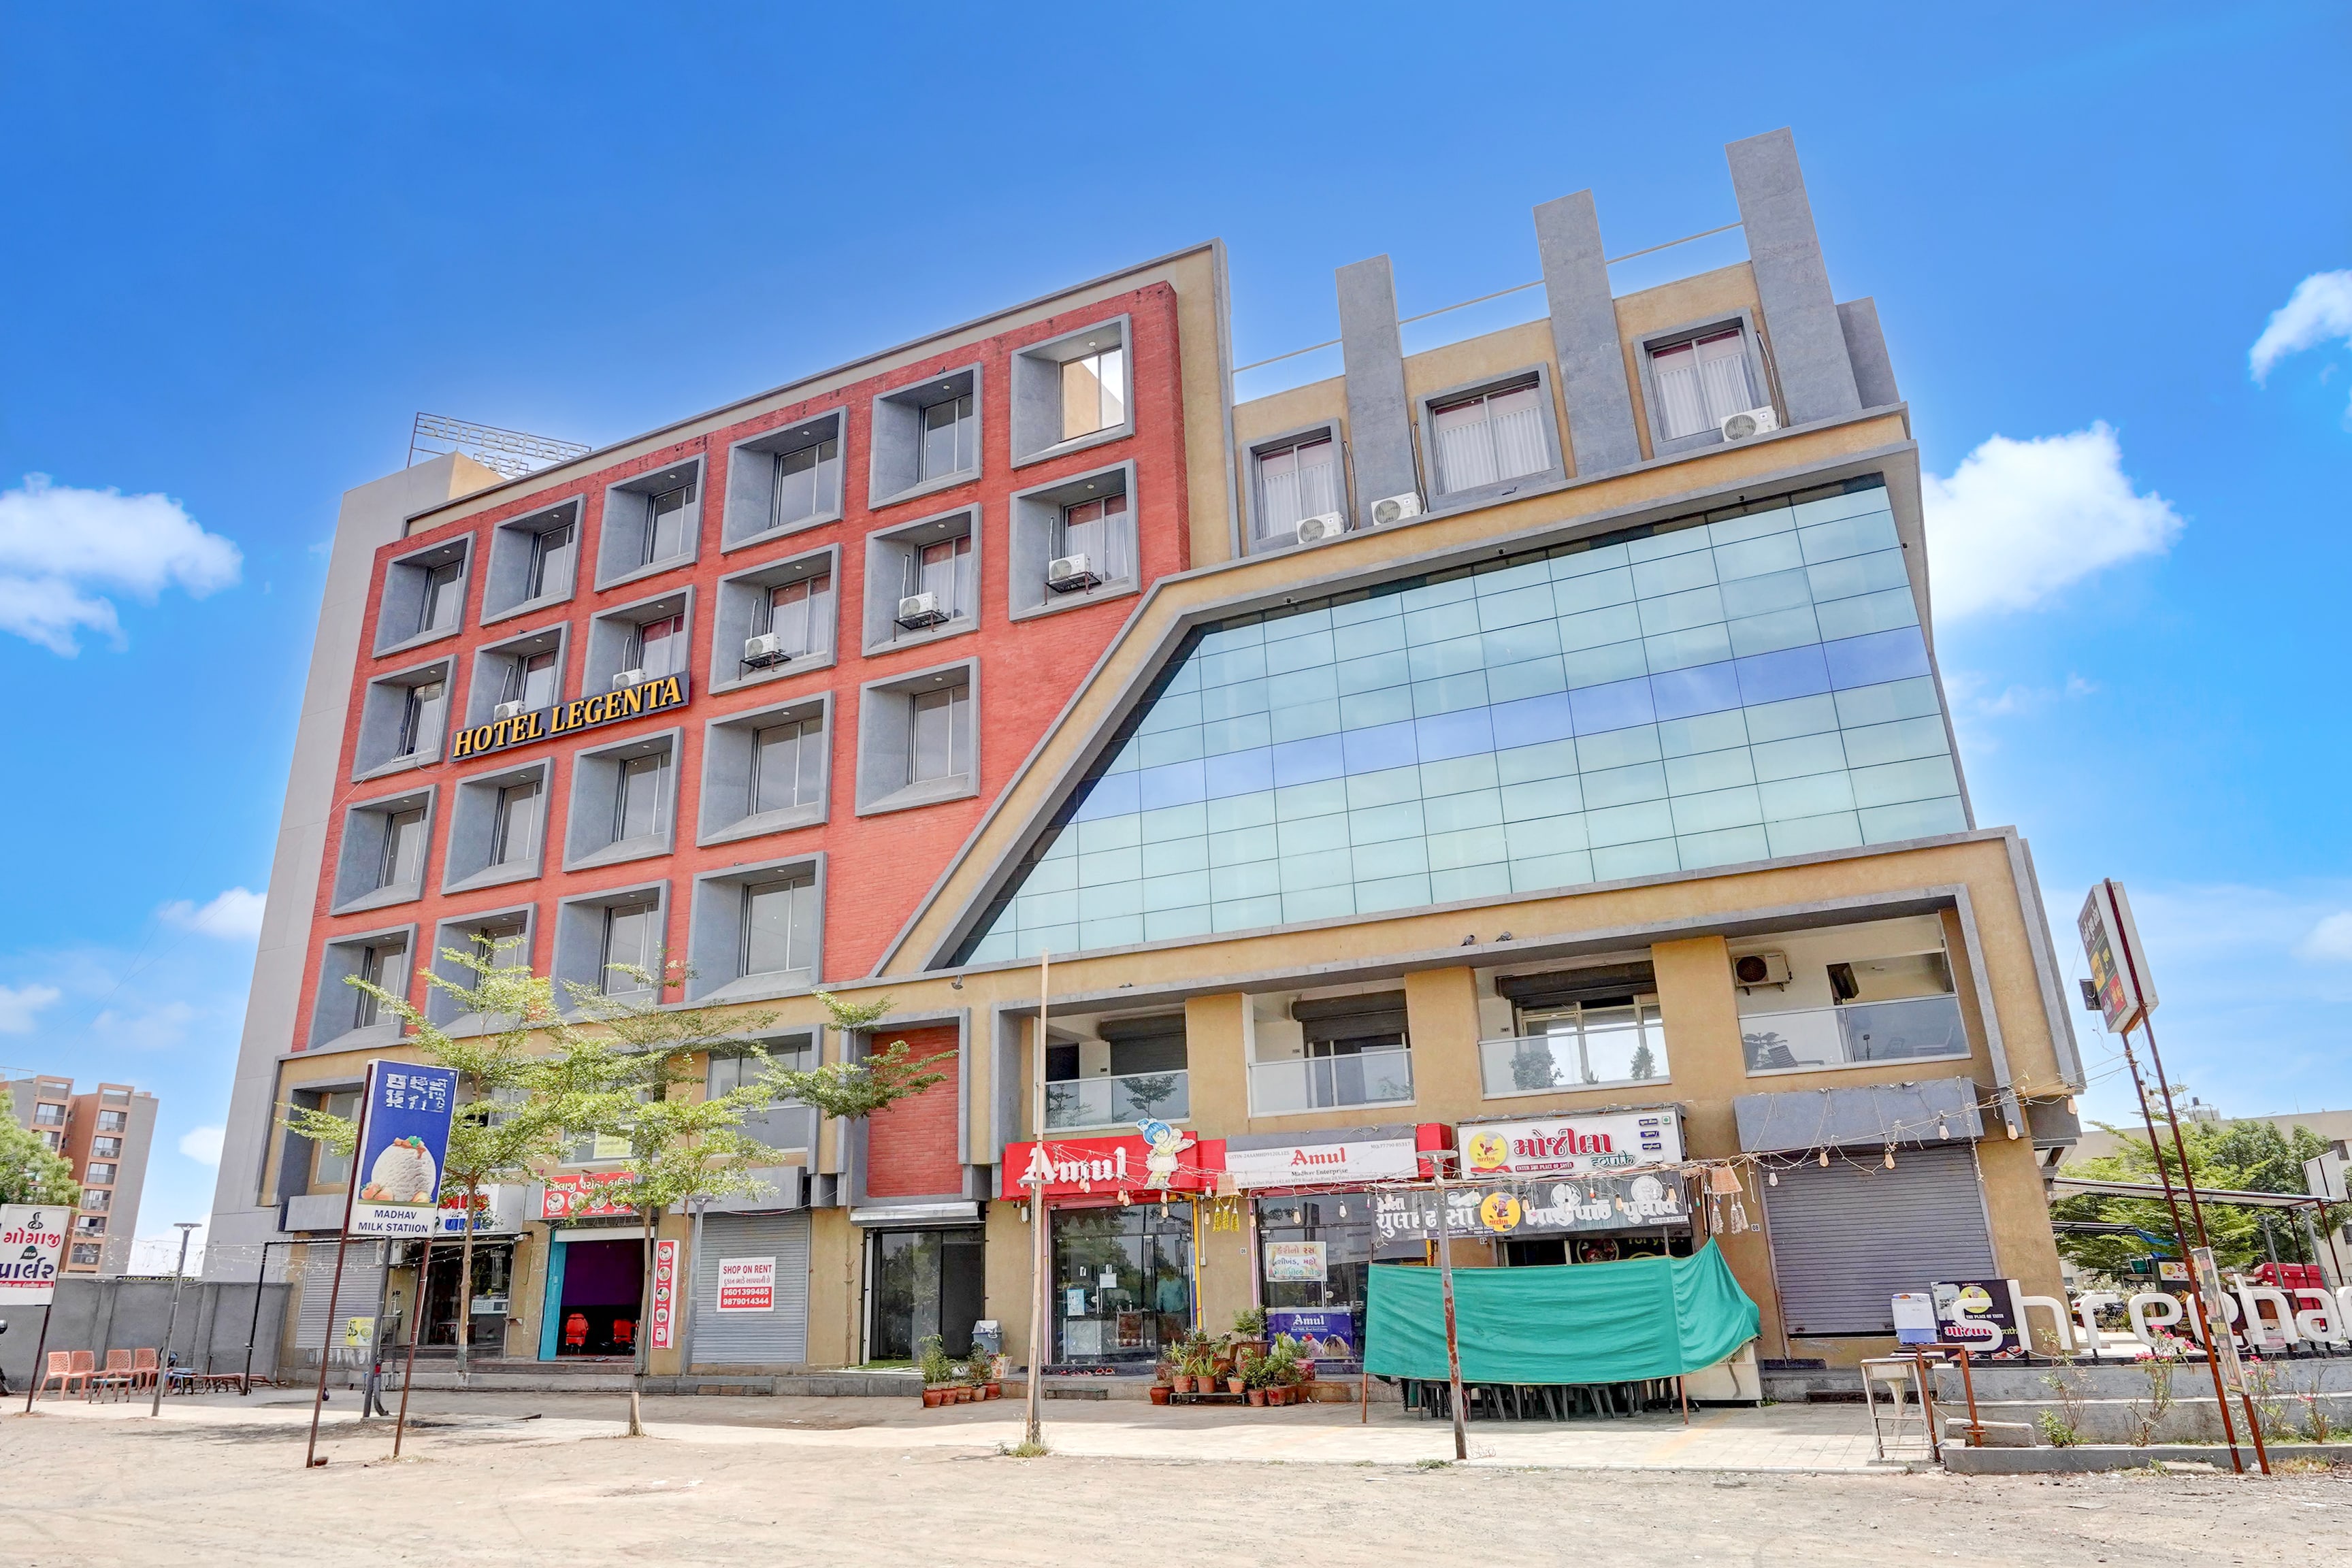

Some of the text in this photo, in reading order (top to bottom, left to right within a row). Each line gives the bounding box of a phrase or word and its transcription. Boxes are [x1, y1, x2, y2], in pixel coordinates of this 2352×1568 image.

[453, 676, 683, 757] HOTEL LEGENTA
[1514, 1127, 1615, 1158] મોજીલા
[1291, 1147, 1346, 1166] Amul
[1590, 1150, 1635, 1166] south
[1019, 1146, 1126, 1187] Amul
[374, 1209, 417, 1220] MADHAV
[358, 1222, 429, 1232] MILK STATIION
[723, 1264, 772, 1274] SHOP ON RENT
[723, 1288, 769, 1296] 9601399485
[723, 1297, 768, 1305] 9879014344
[1293, 1314, 1324, 1326] Amul
